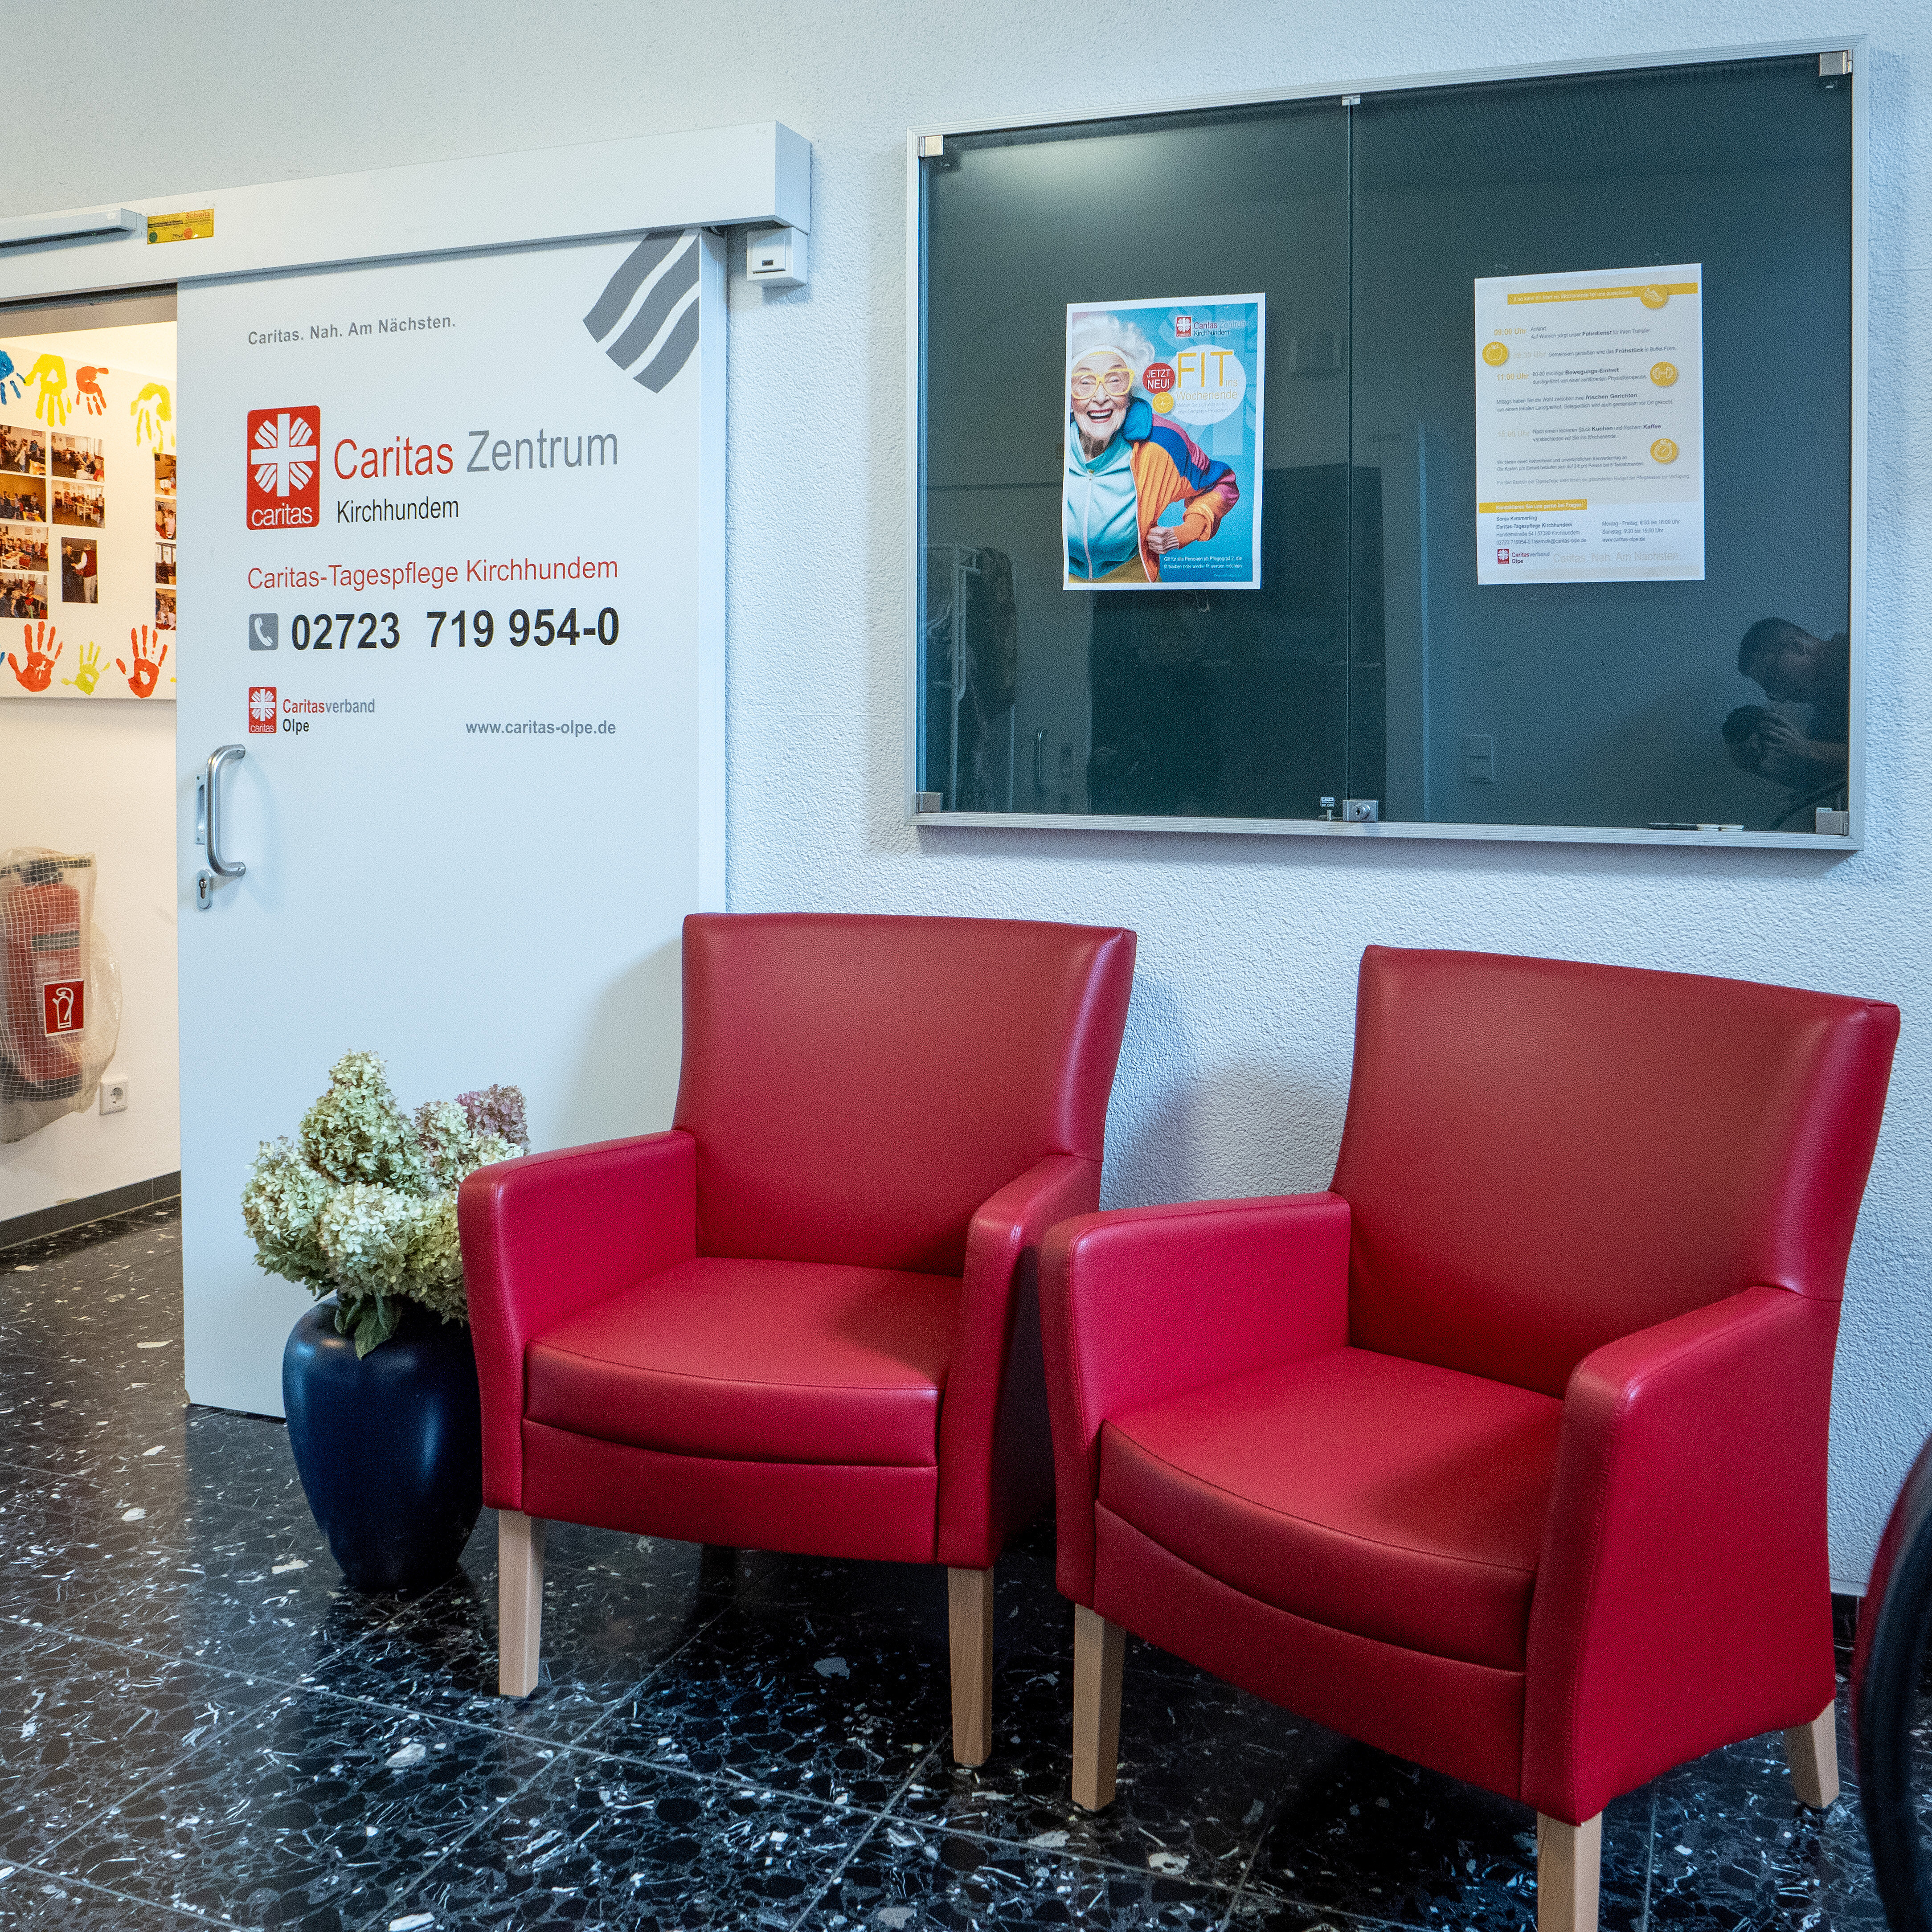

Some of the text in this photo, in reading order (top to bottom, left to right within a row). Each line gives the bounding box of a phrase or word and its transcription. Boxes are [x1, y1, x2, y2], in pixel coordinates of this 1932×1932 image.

[248, 316, 455, 345] Caritas. Nah. Am Nächsten.
[1147, 369, 1171, 378] JETZT
[1178, 351, 1233, 388] FIT
[1148, 379, 1169, 389] NEU!
[1176, 390, 1238, 401] Wochenende
[335, 429, 617, 479] Caritas Zentrum
[252, 503, 312, 526] caritas
[338, 496, 458, 523] Kirchhundem
[248, 557, 617, 591] Caritas-Tagespflege Kirchhundem
[292, 607, 618, 650] 02723 719 954-0
[283, 699, 374, 713] Caritasverband
[250, 724, 274, 733] caritas
[283, 719, 309, 735] Olpe
[466, 720, 616, 737] www.caritas-olpe.de
